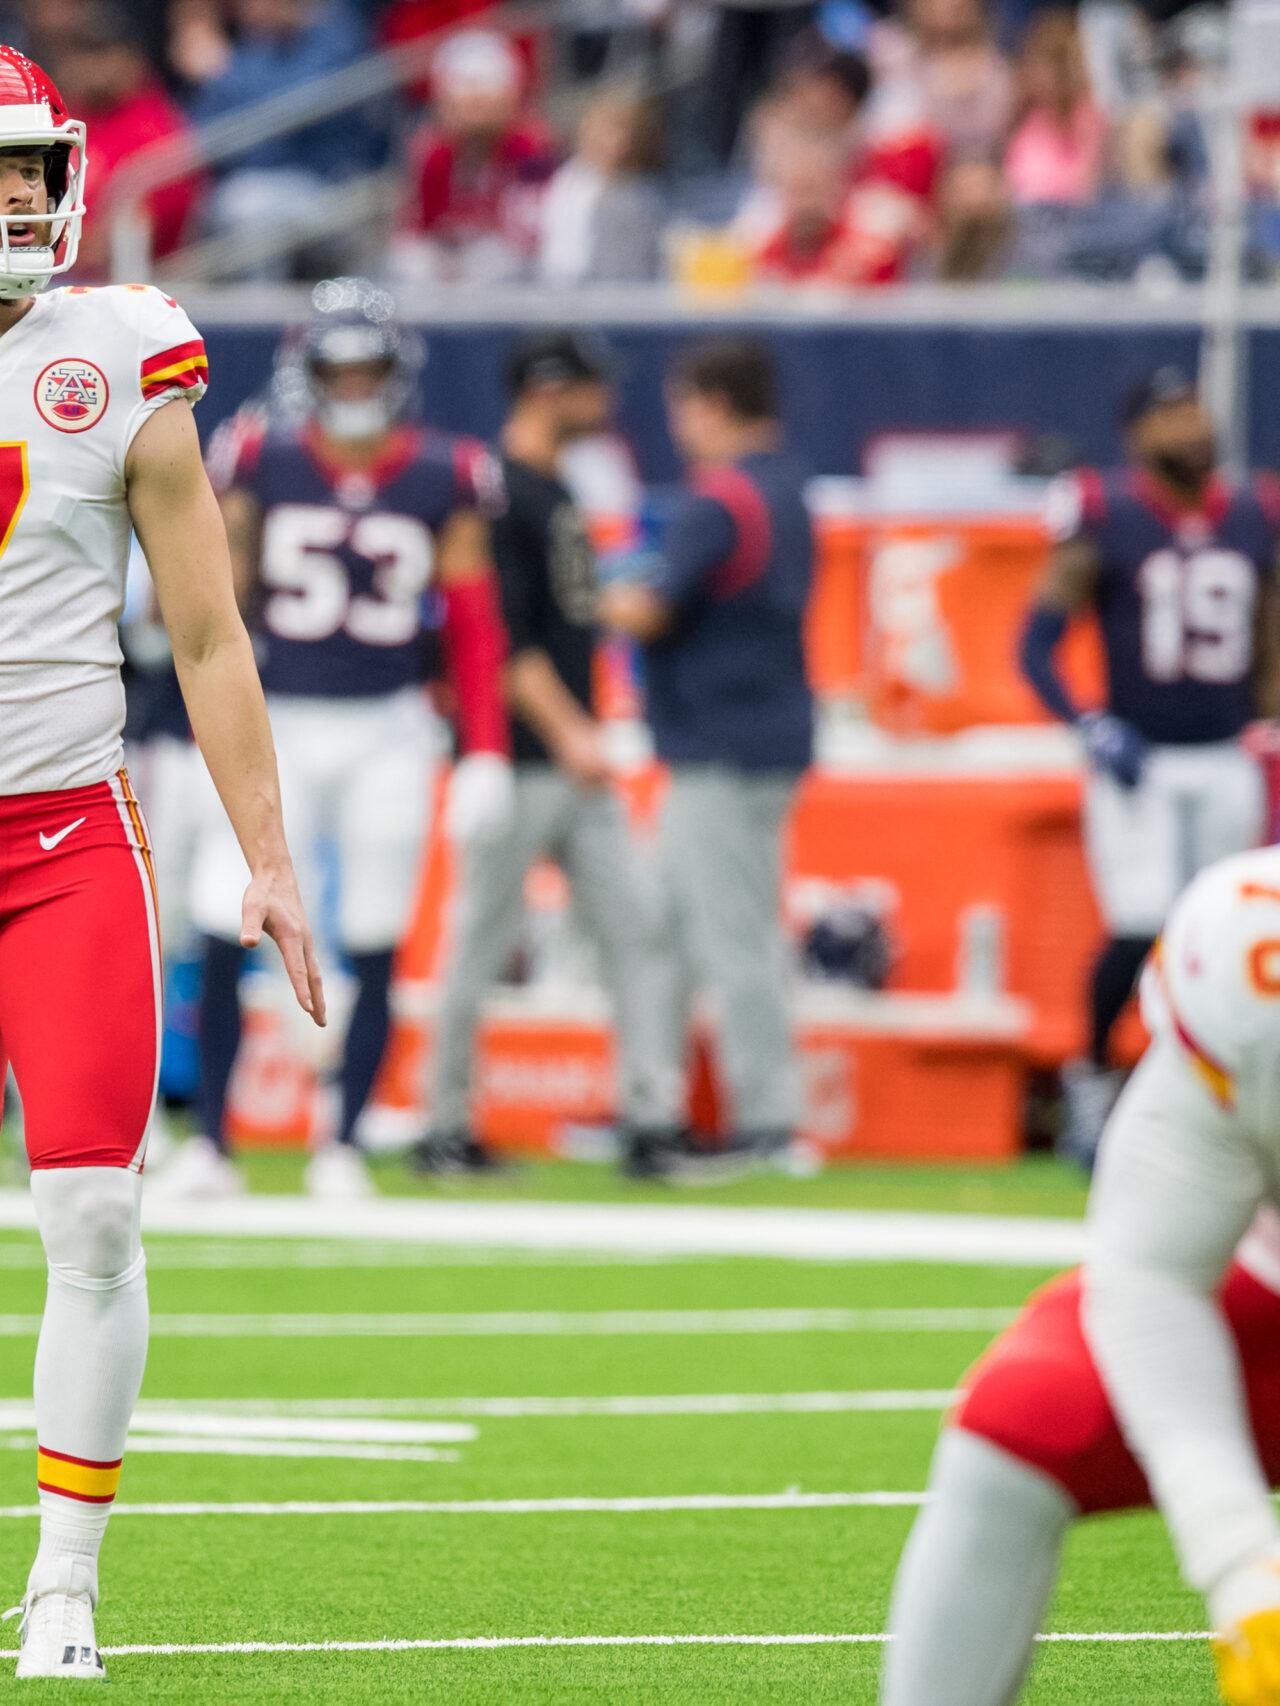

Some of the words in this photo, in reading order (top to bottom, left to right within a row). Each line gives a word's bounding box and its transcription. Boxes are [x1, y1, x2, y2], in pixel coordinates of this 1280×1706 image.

[45, 368, 97, 404] A
[261, 503, 434, 646] 53
[1137, 549, 1257, 684] 19
